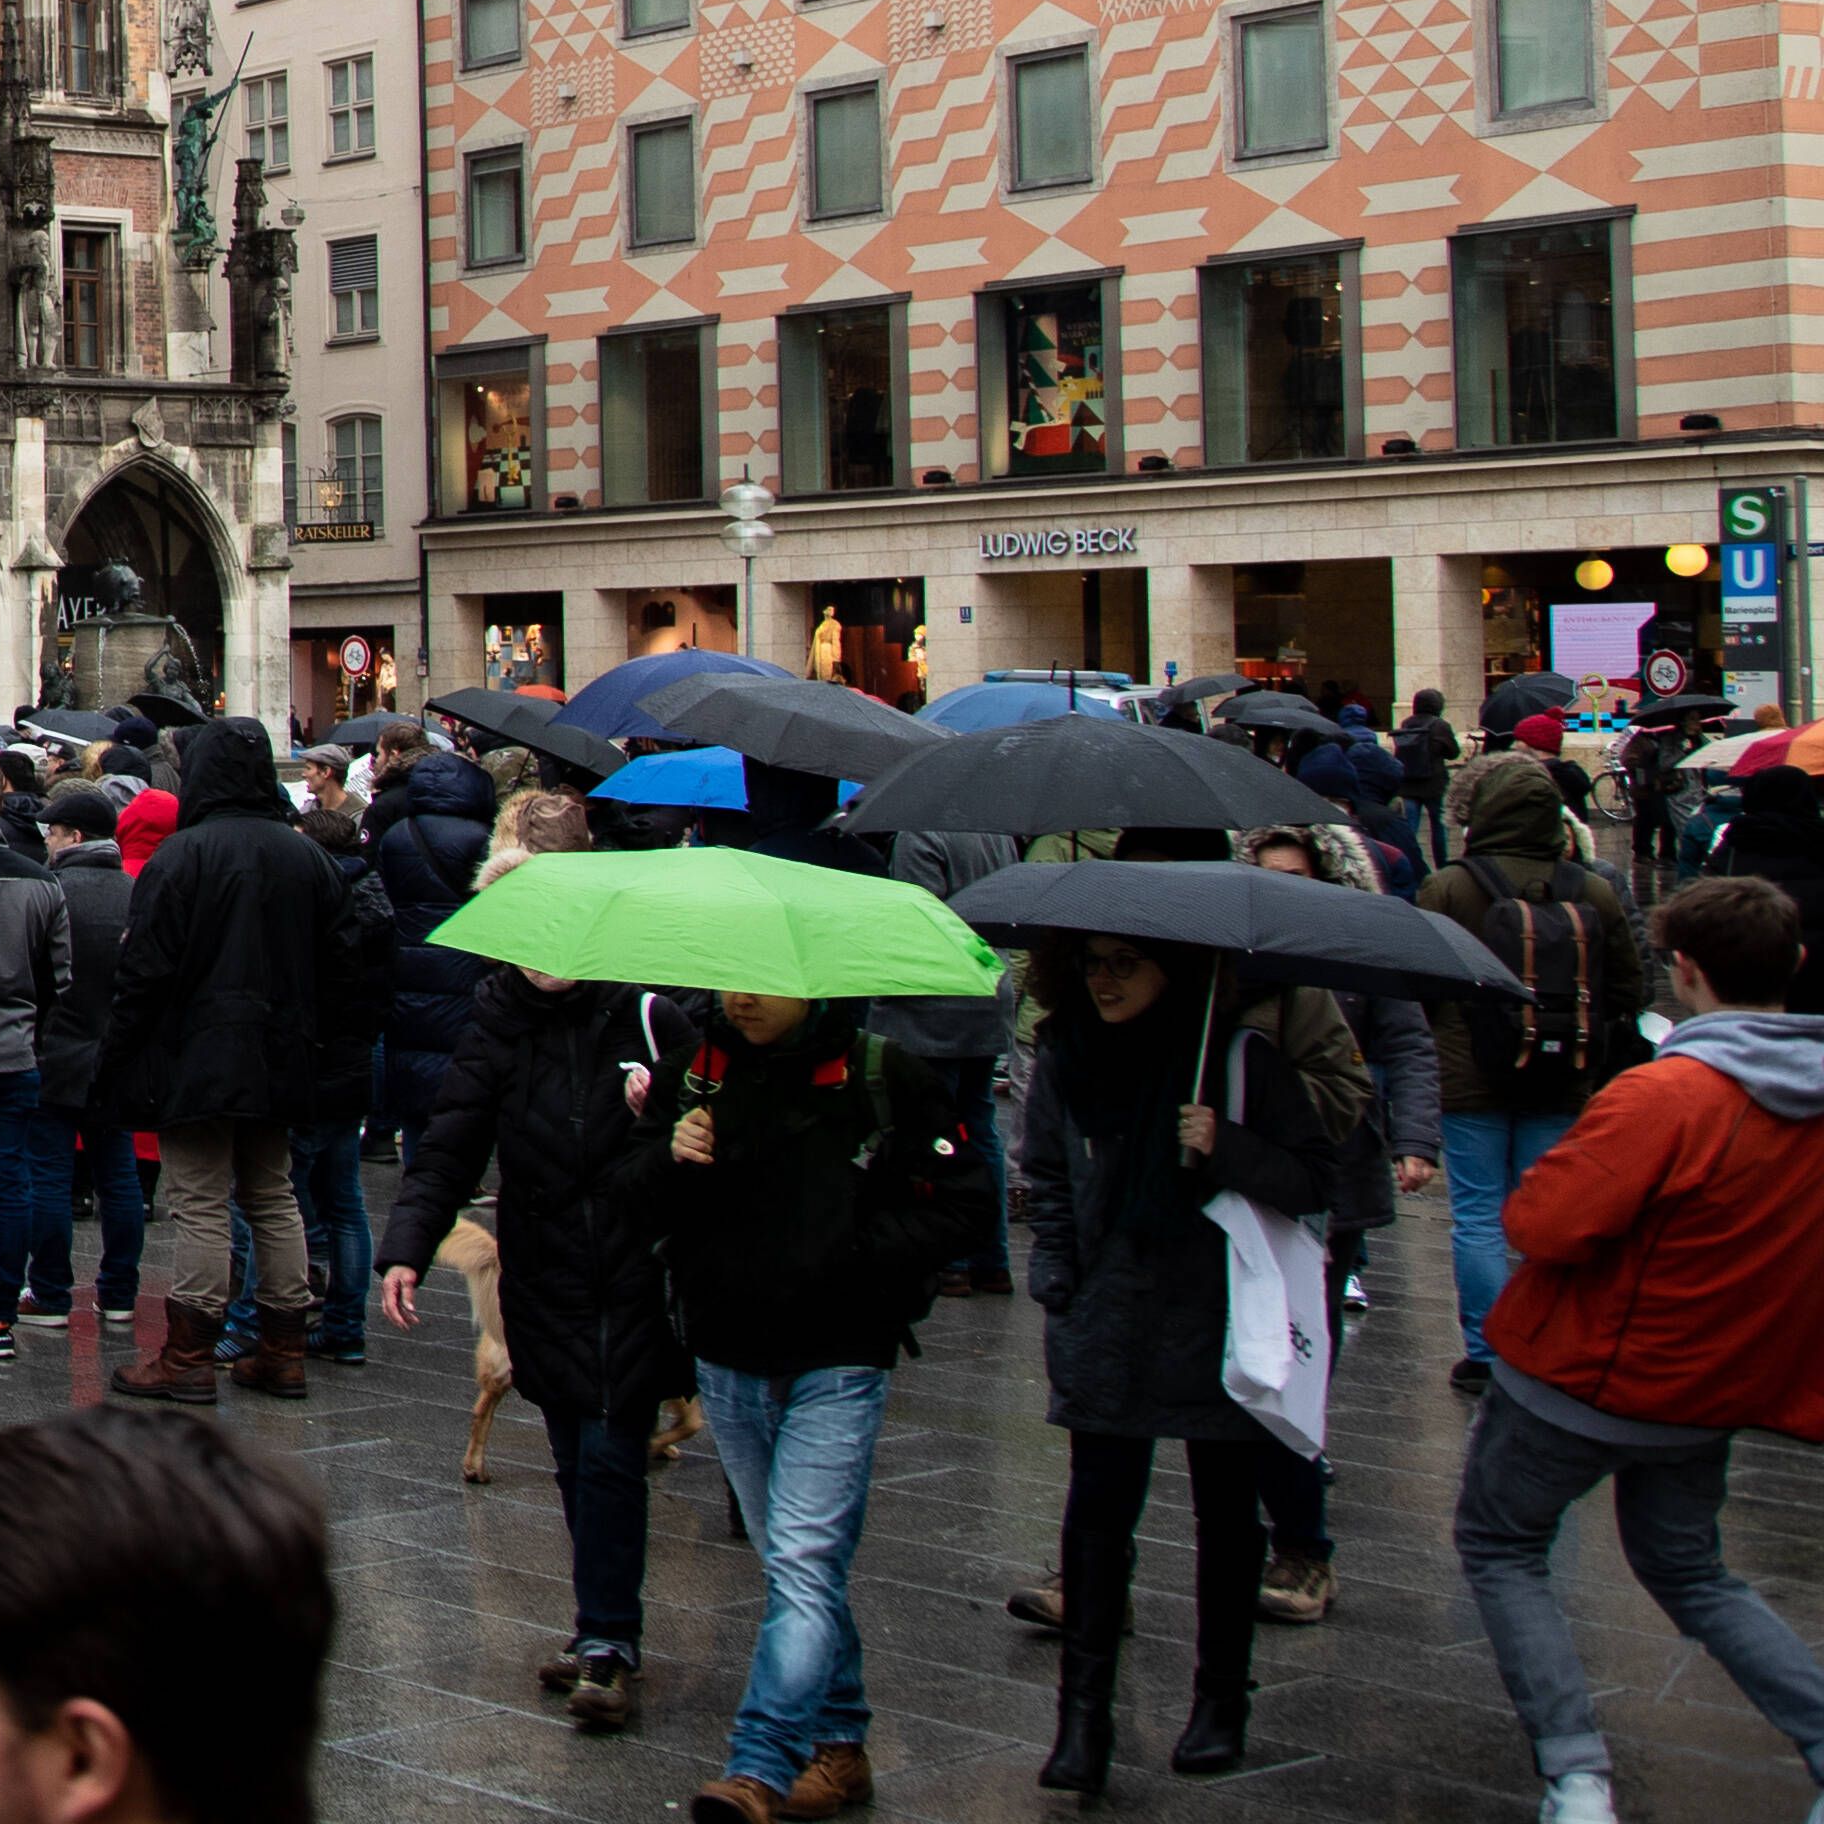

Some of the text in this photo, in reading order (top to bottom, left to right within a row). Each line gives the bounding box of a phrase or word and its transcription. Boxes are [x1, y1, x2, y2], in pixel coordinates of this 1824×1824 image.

[294, 524, 370, 541] RATSKELLER
[1732, 495, 1766, 535] S
[979, 527, 1137, 558] LUDWIG BECK
[1732, 549, 1765, 589] U
